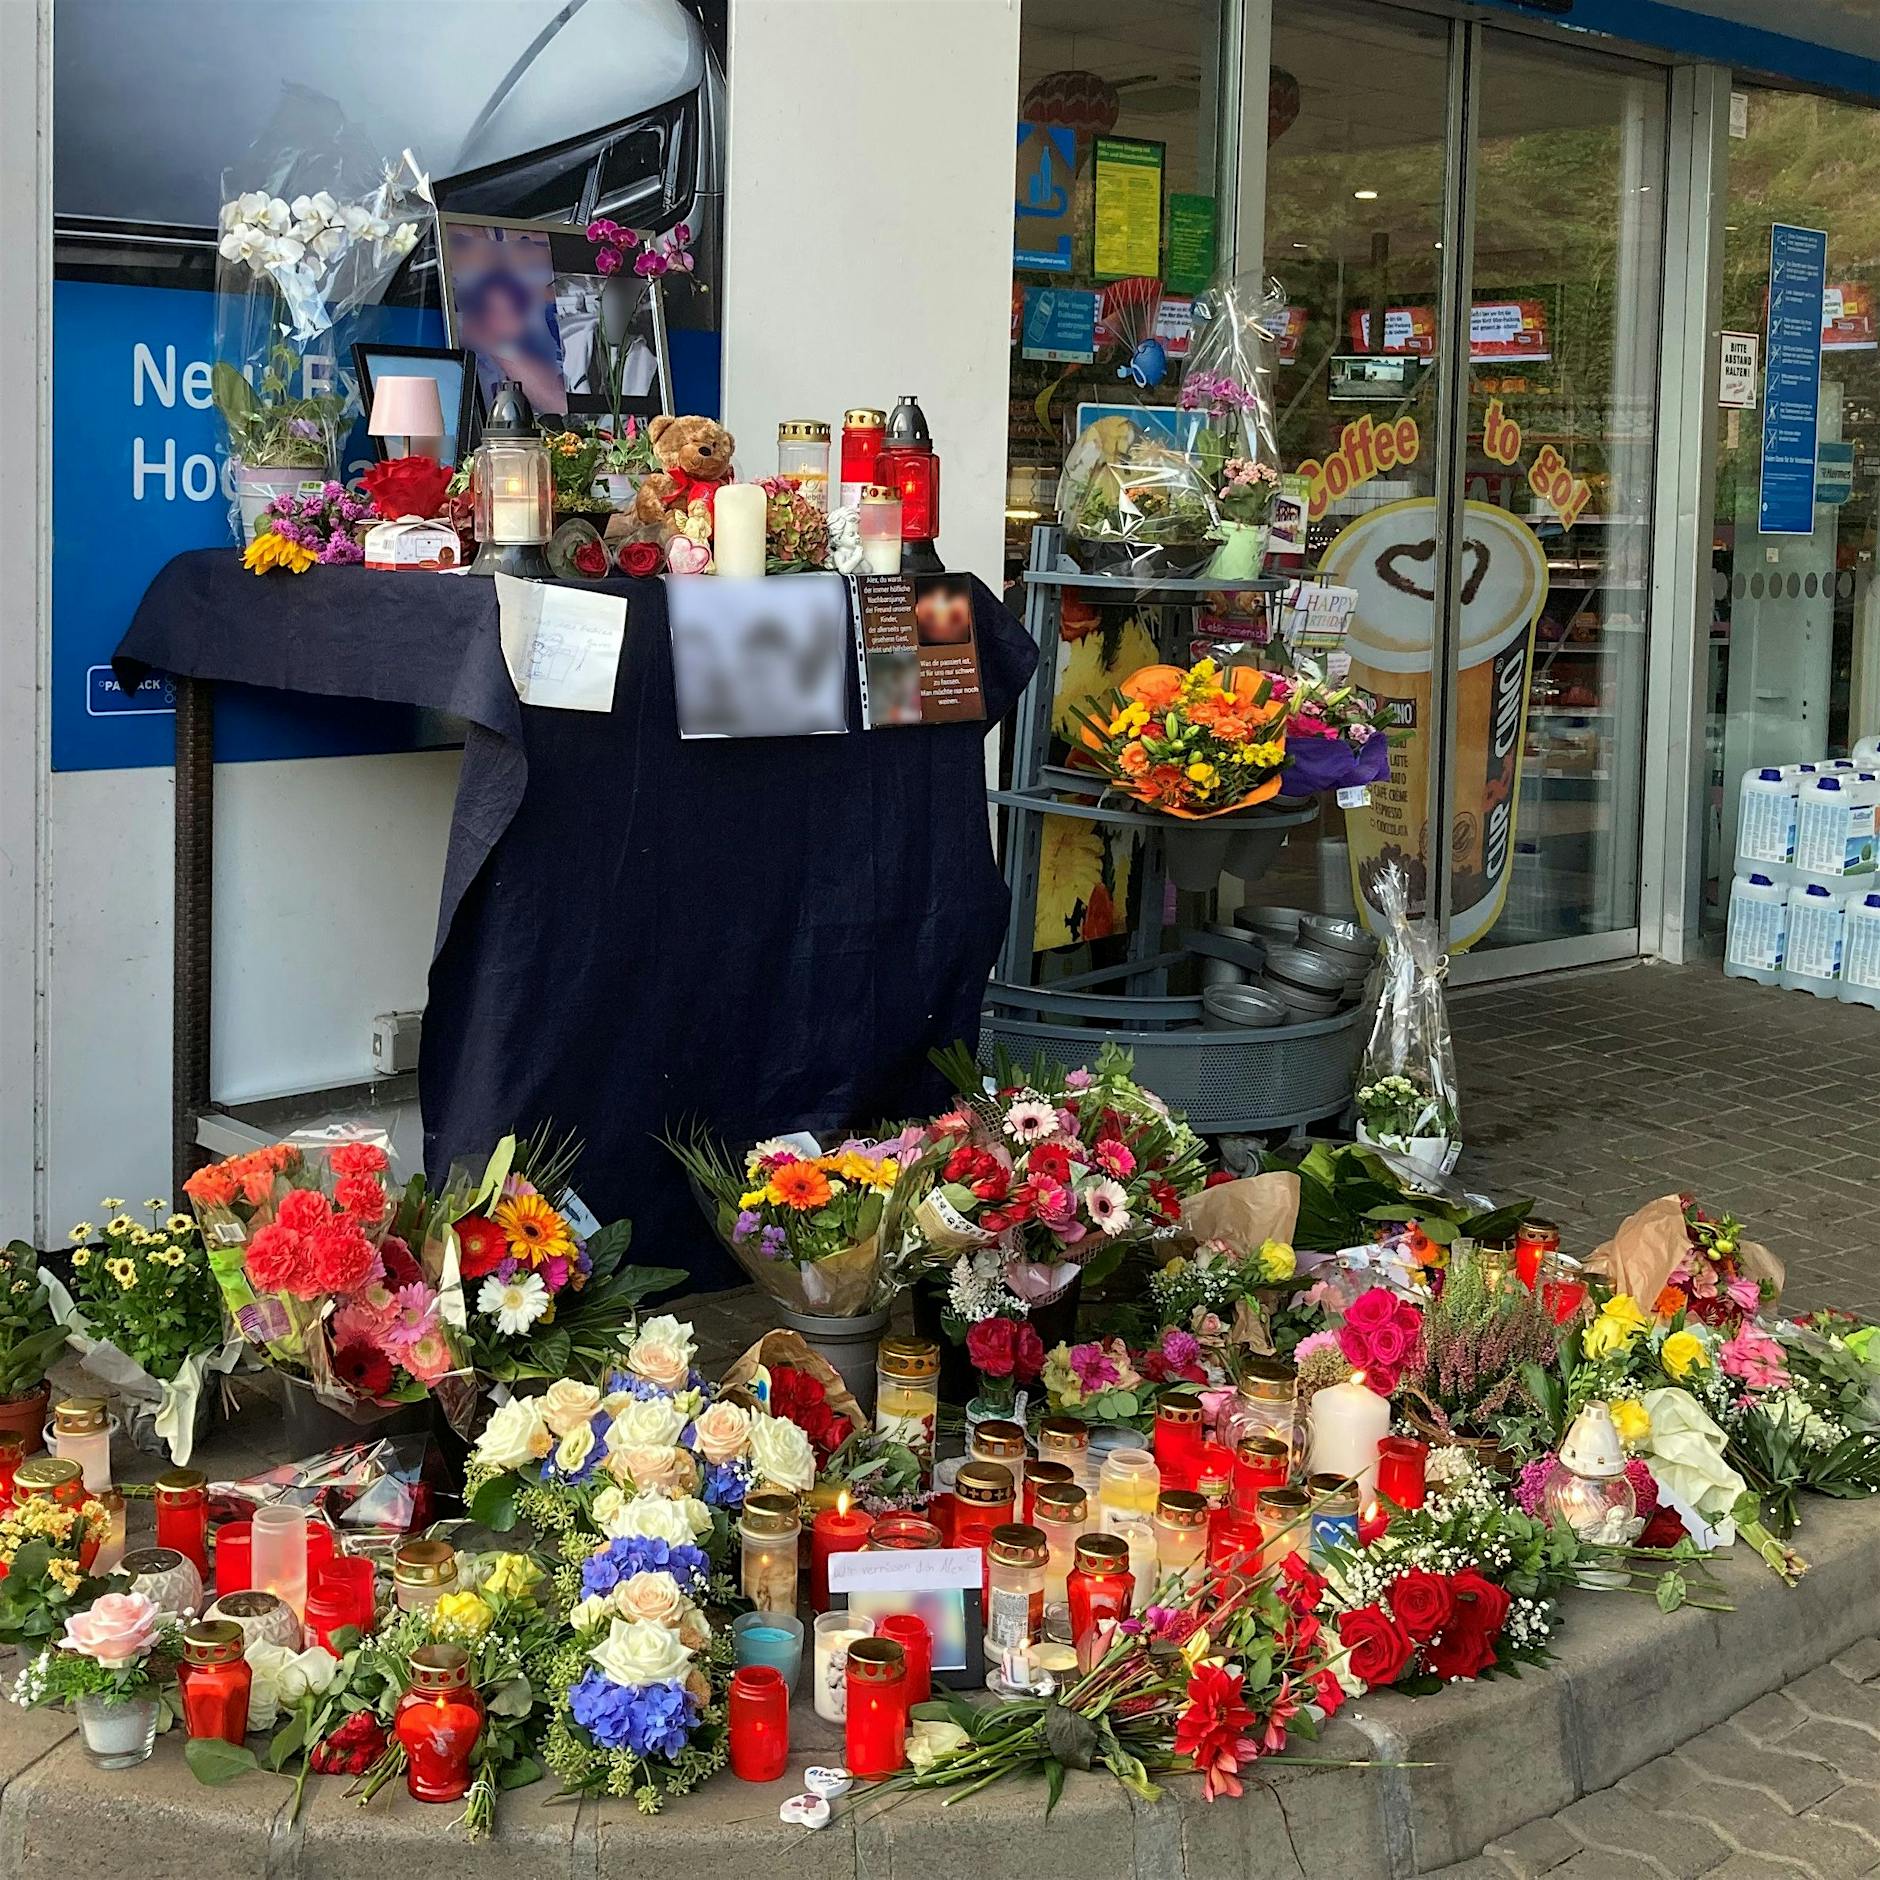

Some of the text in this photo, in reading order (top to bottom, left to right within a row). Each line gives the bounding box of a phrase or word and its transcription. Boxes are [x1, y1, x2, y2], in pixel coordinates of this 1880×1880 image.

[1731, 342, 1747, 354] BITTE
[1725, 354, 1751, 366] ABSTAND
[1725, 366, 1750, 377] HALTEN!
[1298, 402, 1590, 526] Coffee to go!
[105, 680, 160, 691] PAACK
